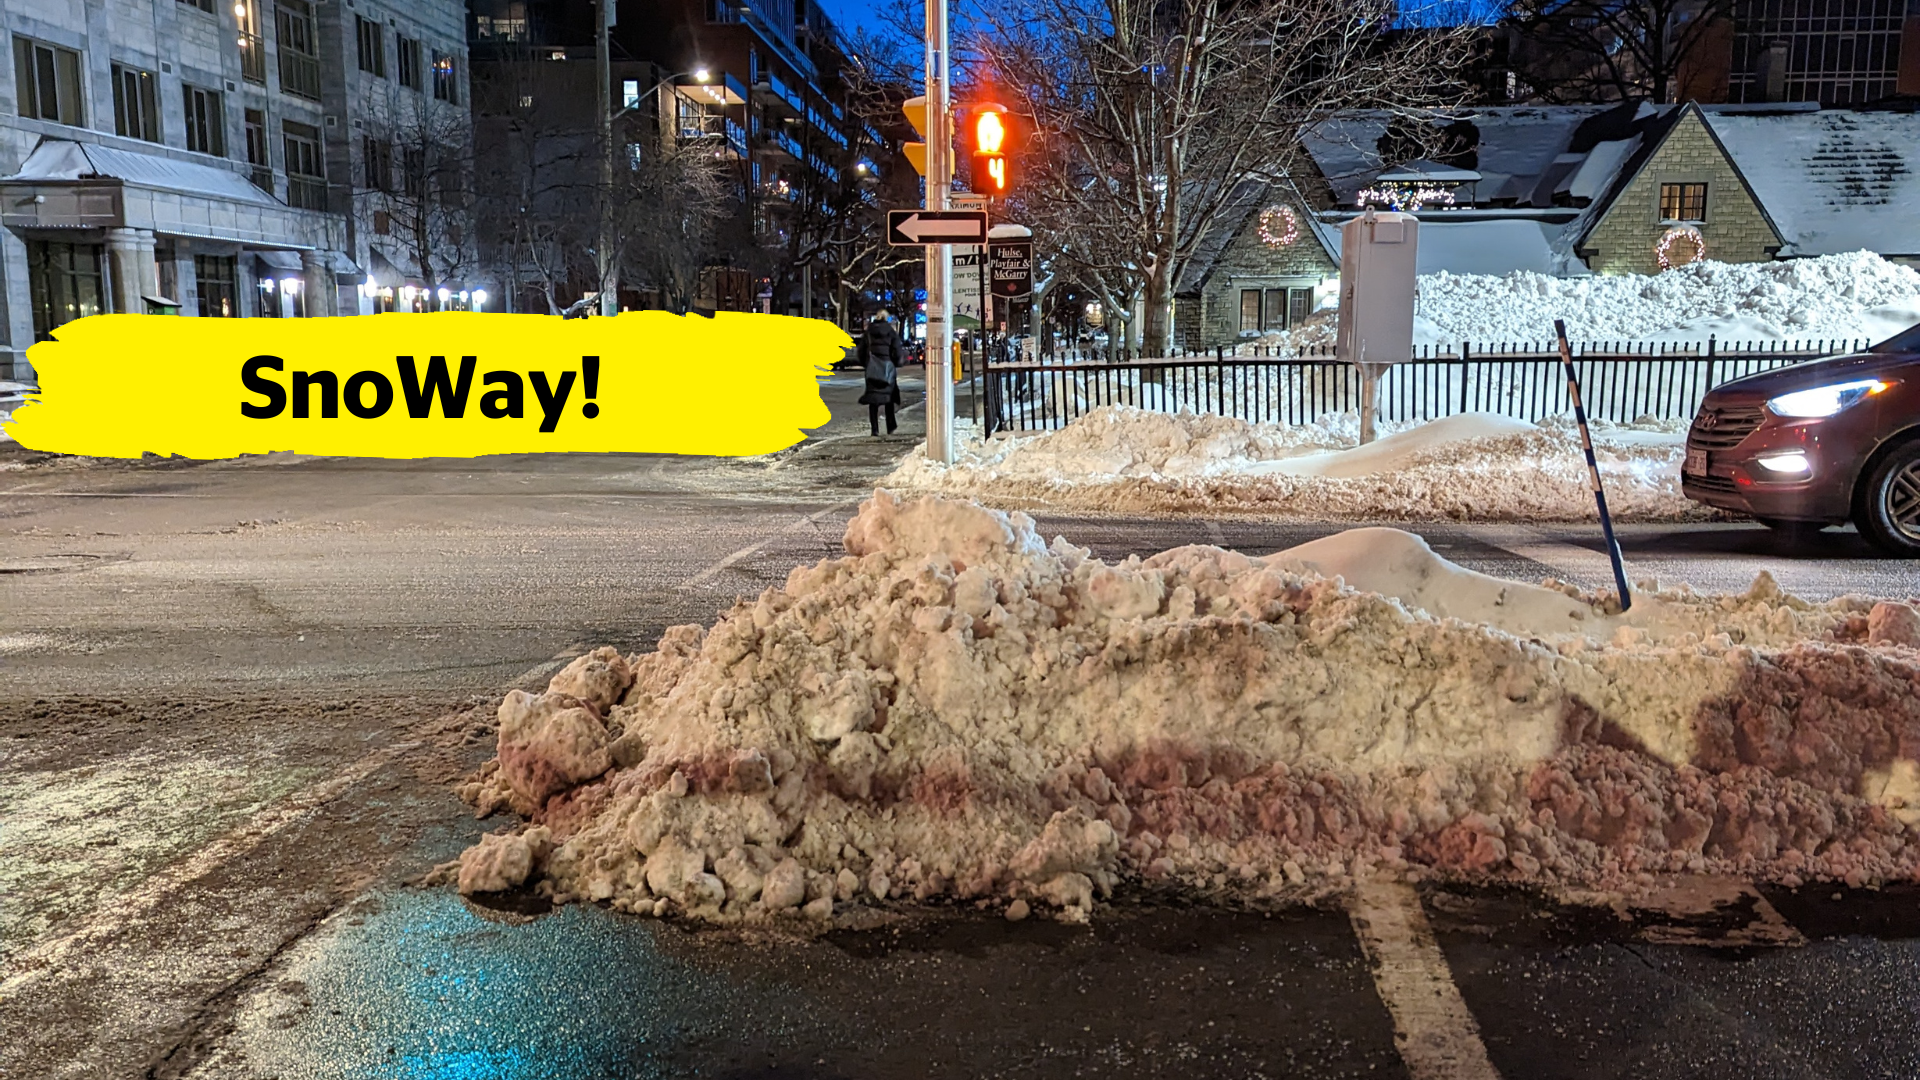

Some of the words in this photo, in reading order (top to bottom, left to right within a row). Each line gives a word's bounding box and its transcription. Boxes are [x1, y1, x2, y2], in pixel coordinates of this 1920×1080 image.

[989, 158, 1004, 189] 4
[990, 258, 1020, 269] Playfair
[1022, 258, 1031, 268] &
[994, 269, 1028, 280] McGarry
